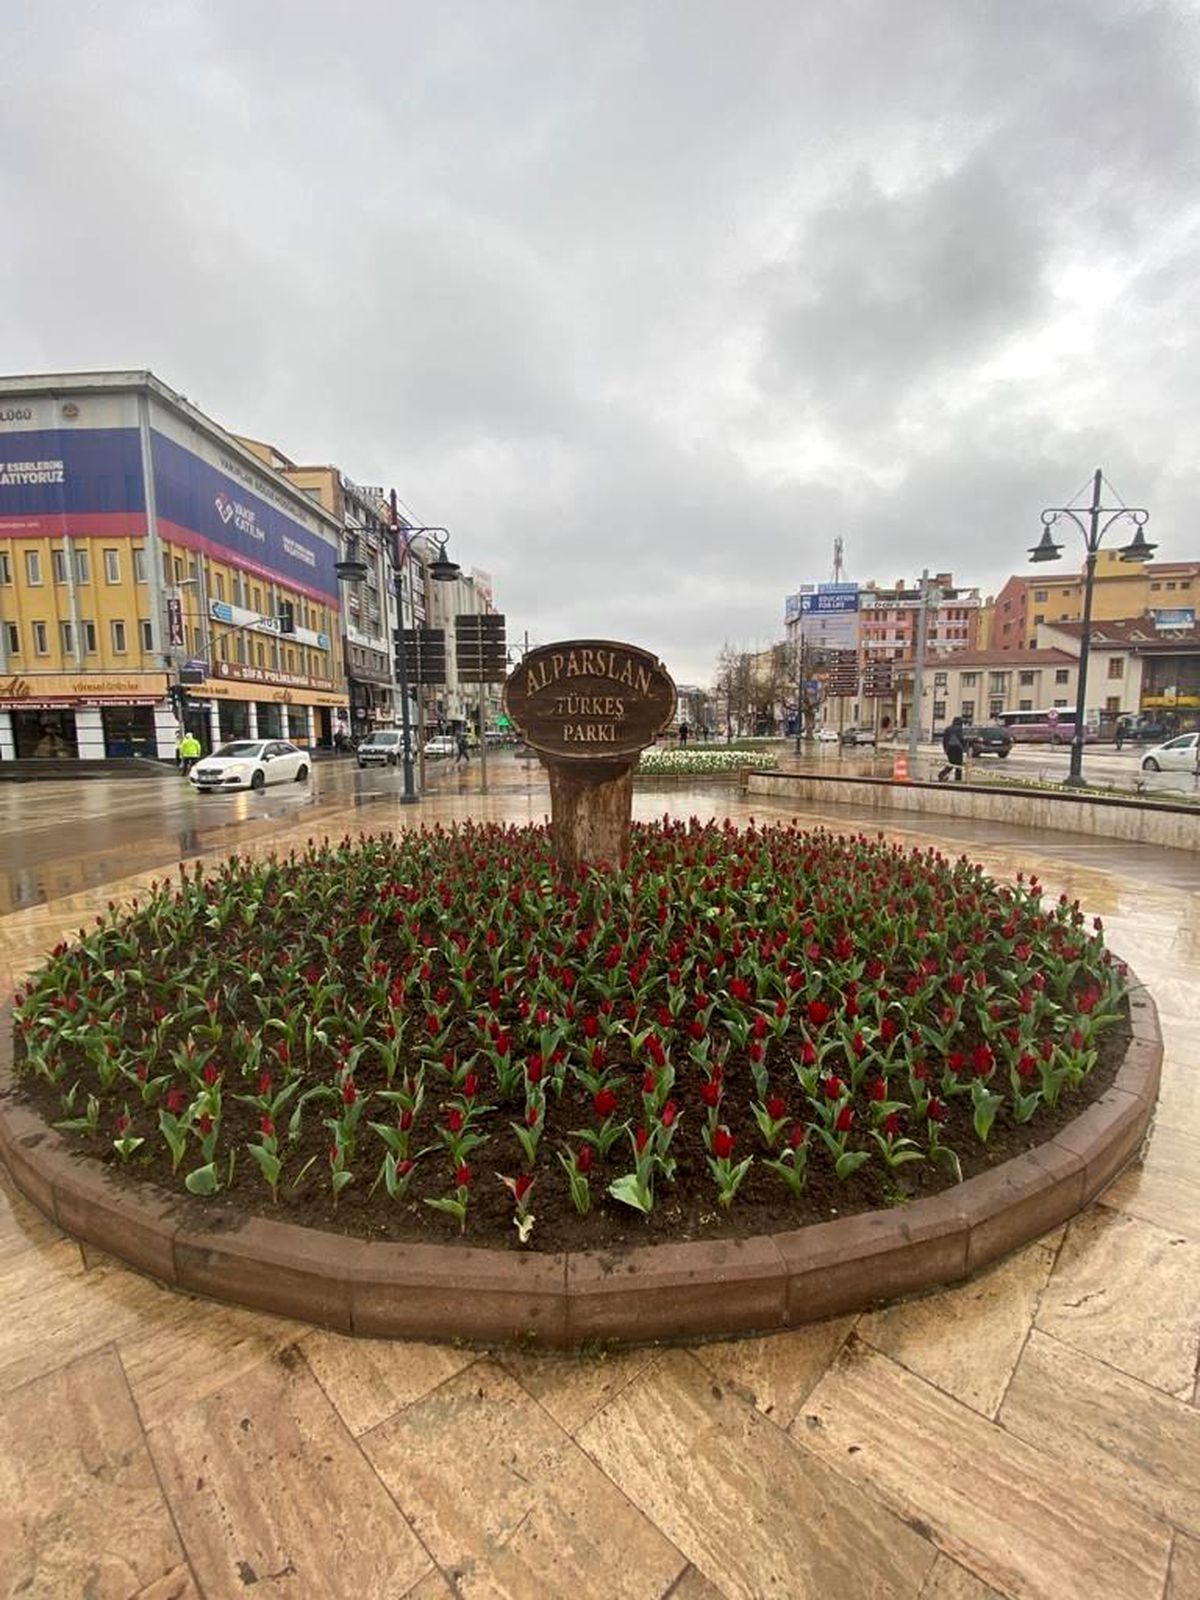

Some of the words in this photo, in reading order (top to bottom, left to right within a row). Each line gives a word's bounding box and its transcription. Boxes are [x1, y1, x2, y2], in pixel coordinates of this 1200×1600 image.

[526, 649, 652, 697] ALPARSLAN
[556, 692, 625, 720] TÜRKEŞ
[563, 724, 616, 741] PARKI
